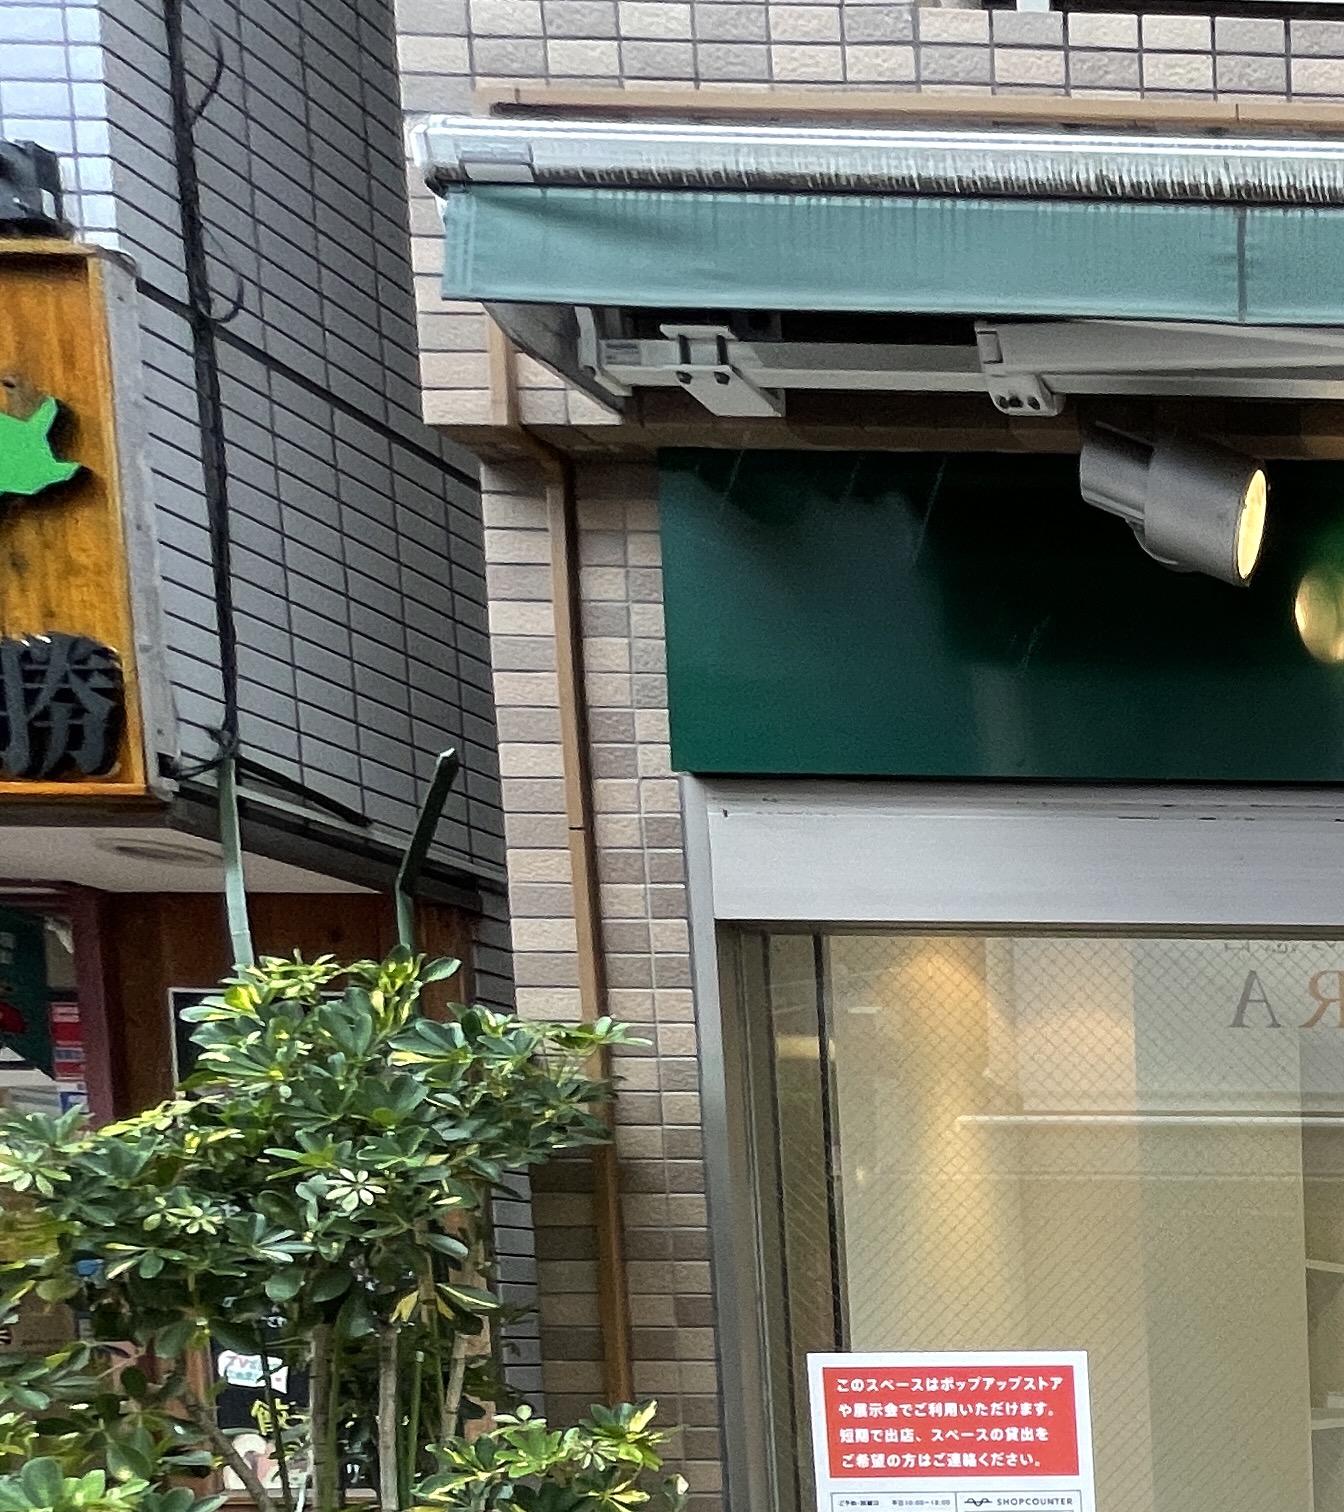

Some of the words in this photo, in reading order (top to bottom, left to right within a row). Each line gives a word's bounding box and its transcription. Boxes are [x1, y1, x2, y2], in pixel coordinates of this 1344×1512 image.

[837, 1376, 1064, 1393] このスペースはポップアップストア
[839, 1402, 1054, 1418] や展示会でご利用いただけます。
[997, 1497, 1074, 1507] SHOPCOUNTER
